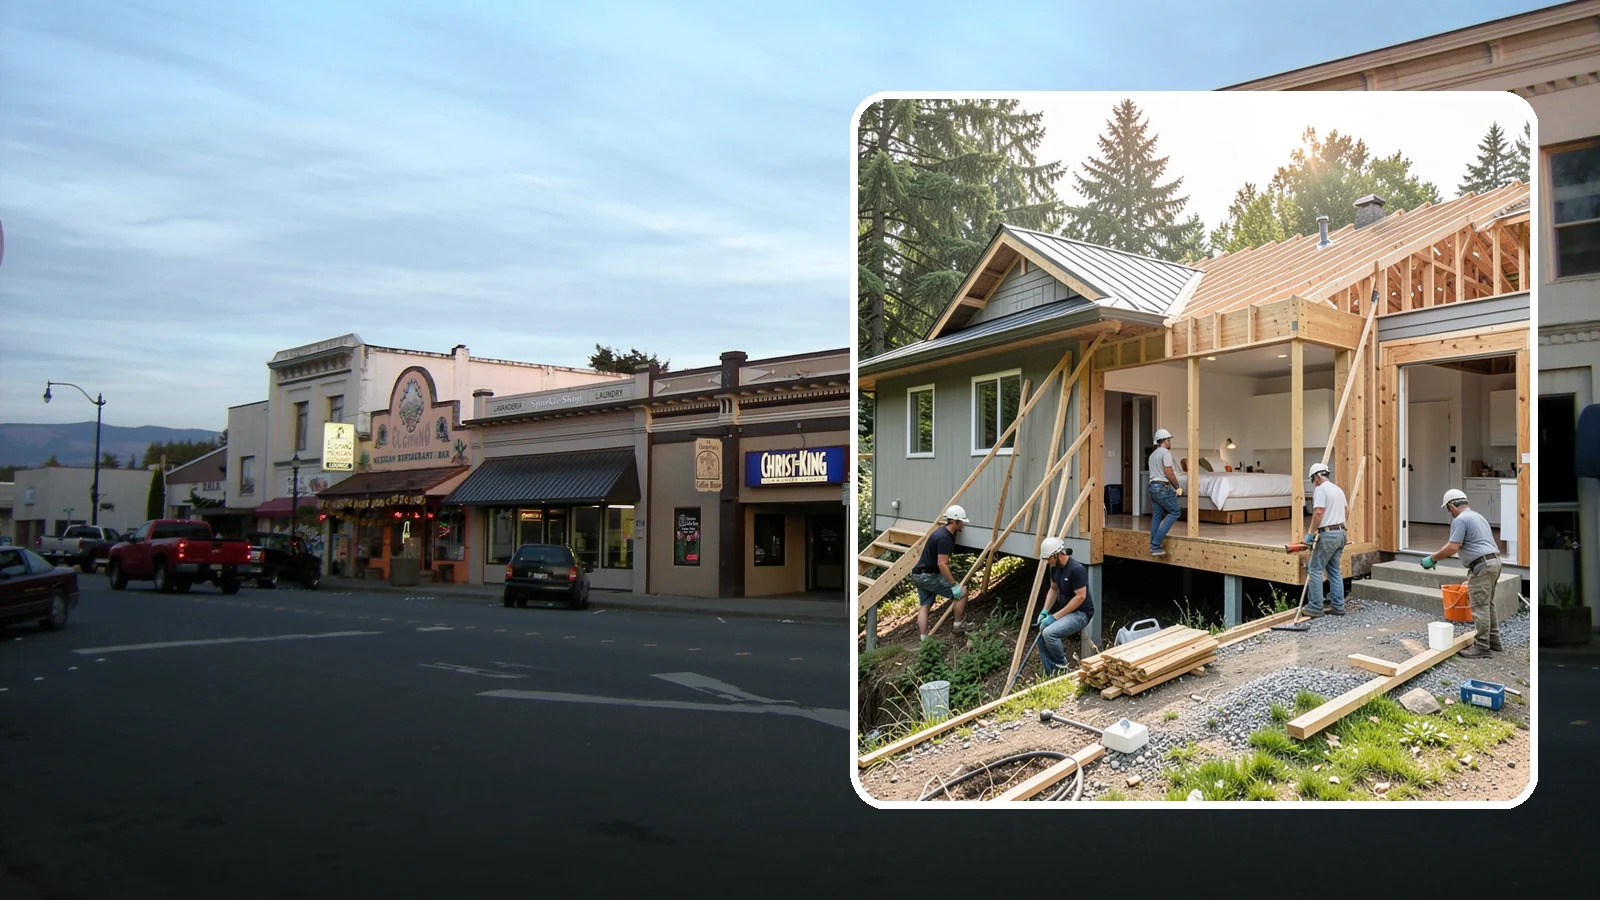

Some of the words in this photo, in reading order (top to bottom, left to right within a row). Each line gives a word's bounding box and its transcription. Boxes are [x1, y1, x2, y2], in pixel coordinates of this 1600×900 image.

[493, 402, 522, 412] LAVANDERIA
[531, 398, 561, 408] Sparkle
[562, 394, 582, 405] Shop
[596, 389, 623, 400] LAUNDRY
[373, 455, 396, 464] MEXICAN
[397, 451, 433, 462] RESTAURANT
[438, 450, 449, 459] BAR
[761, 452, 797, 478] CHRIST
[799, 450, 827, 476] KING
